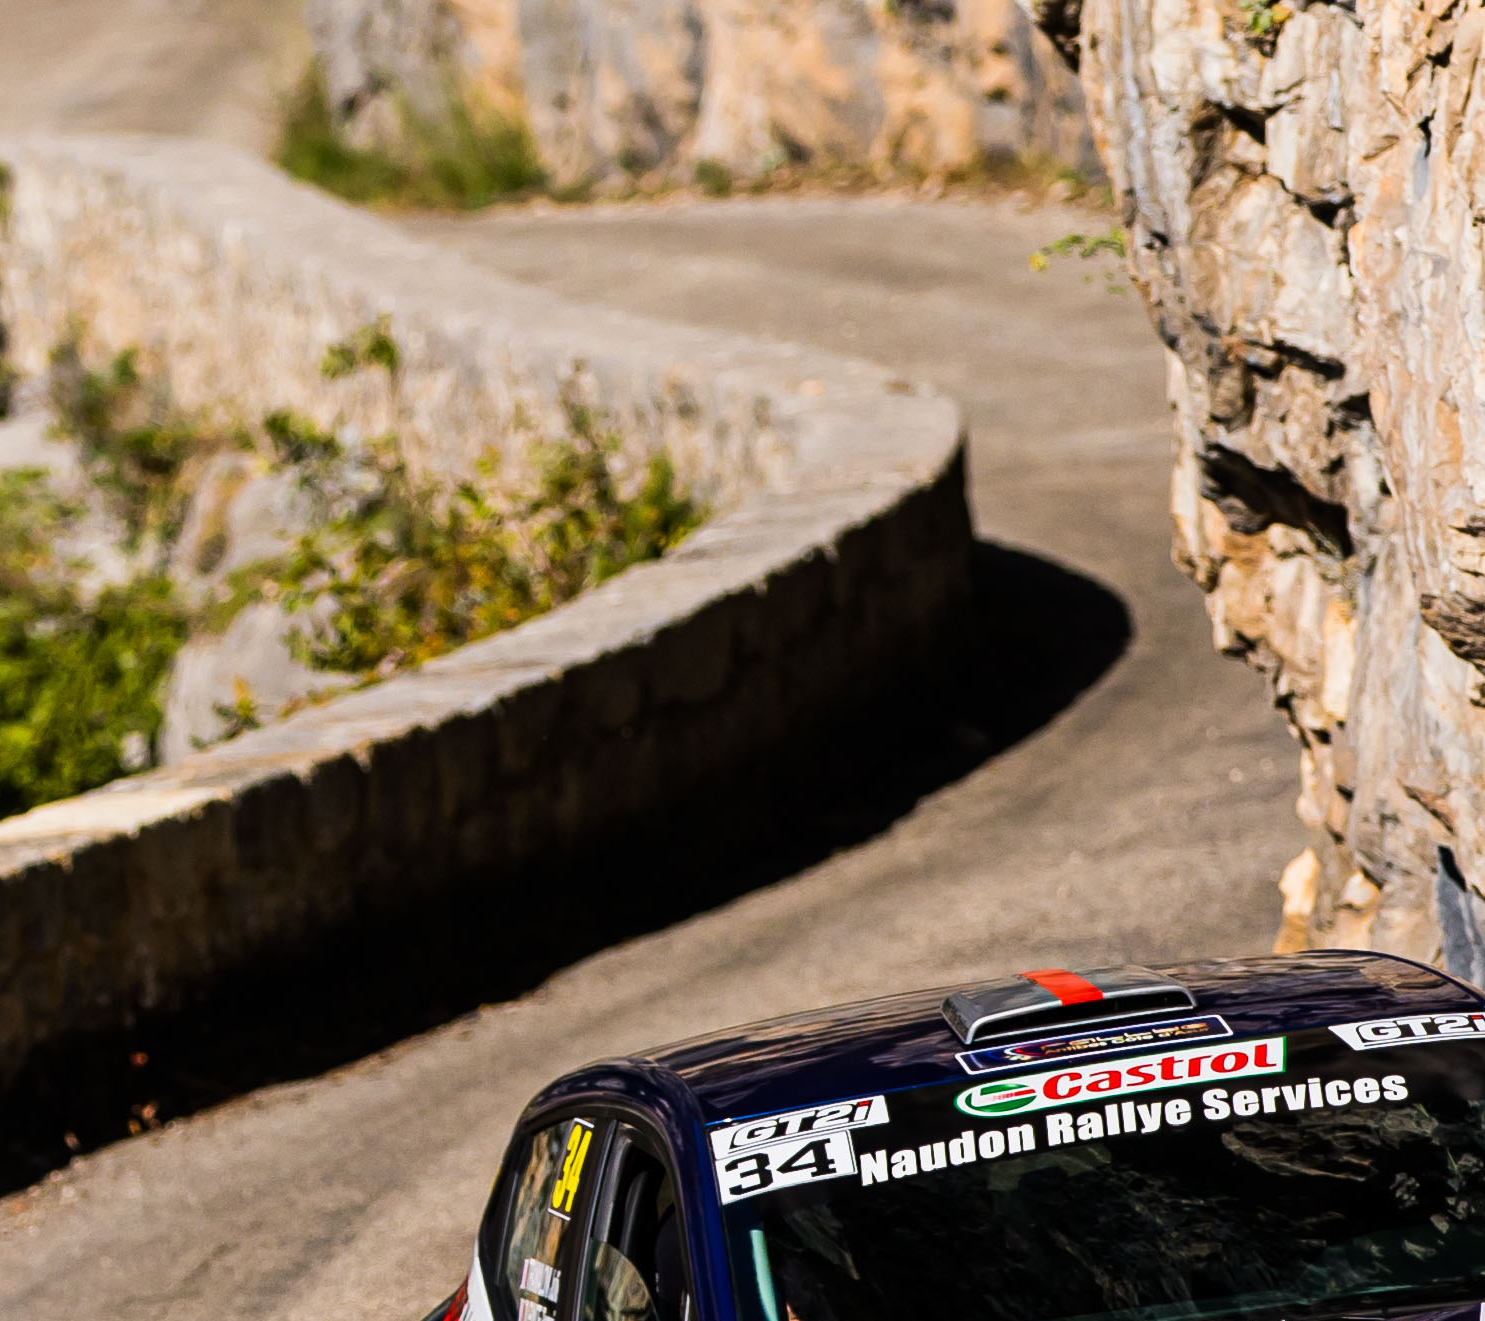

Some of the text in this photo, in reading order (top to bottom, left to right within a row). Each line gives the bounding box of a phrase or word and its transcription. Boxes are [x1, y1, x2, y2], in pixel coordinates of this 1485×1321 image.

[1043, 1043, 1277, 1100] Castrol
[732, 1101, 871, 1147] GT2i
[861, 1074, 1409, 1186] Naudon Rallye Services
[552, 1124, 592, 1212] 34
[725, 1139, 836, 1195] 34
